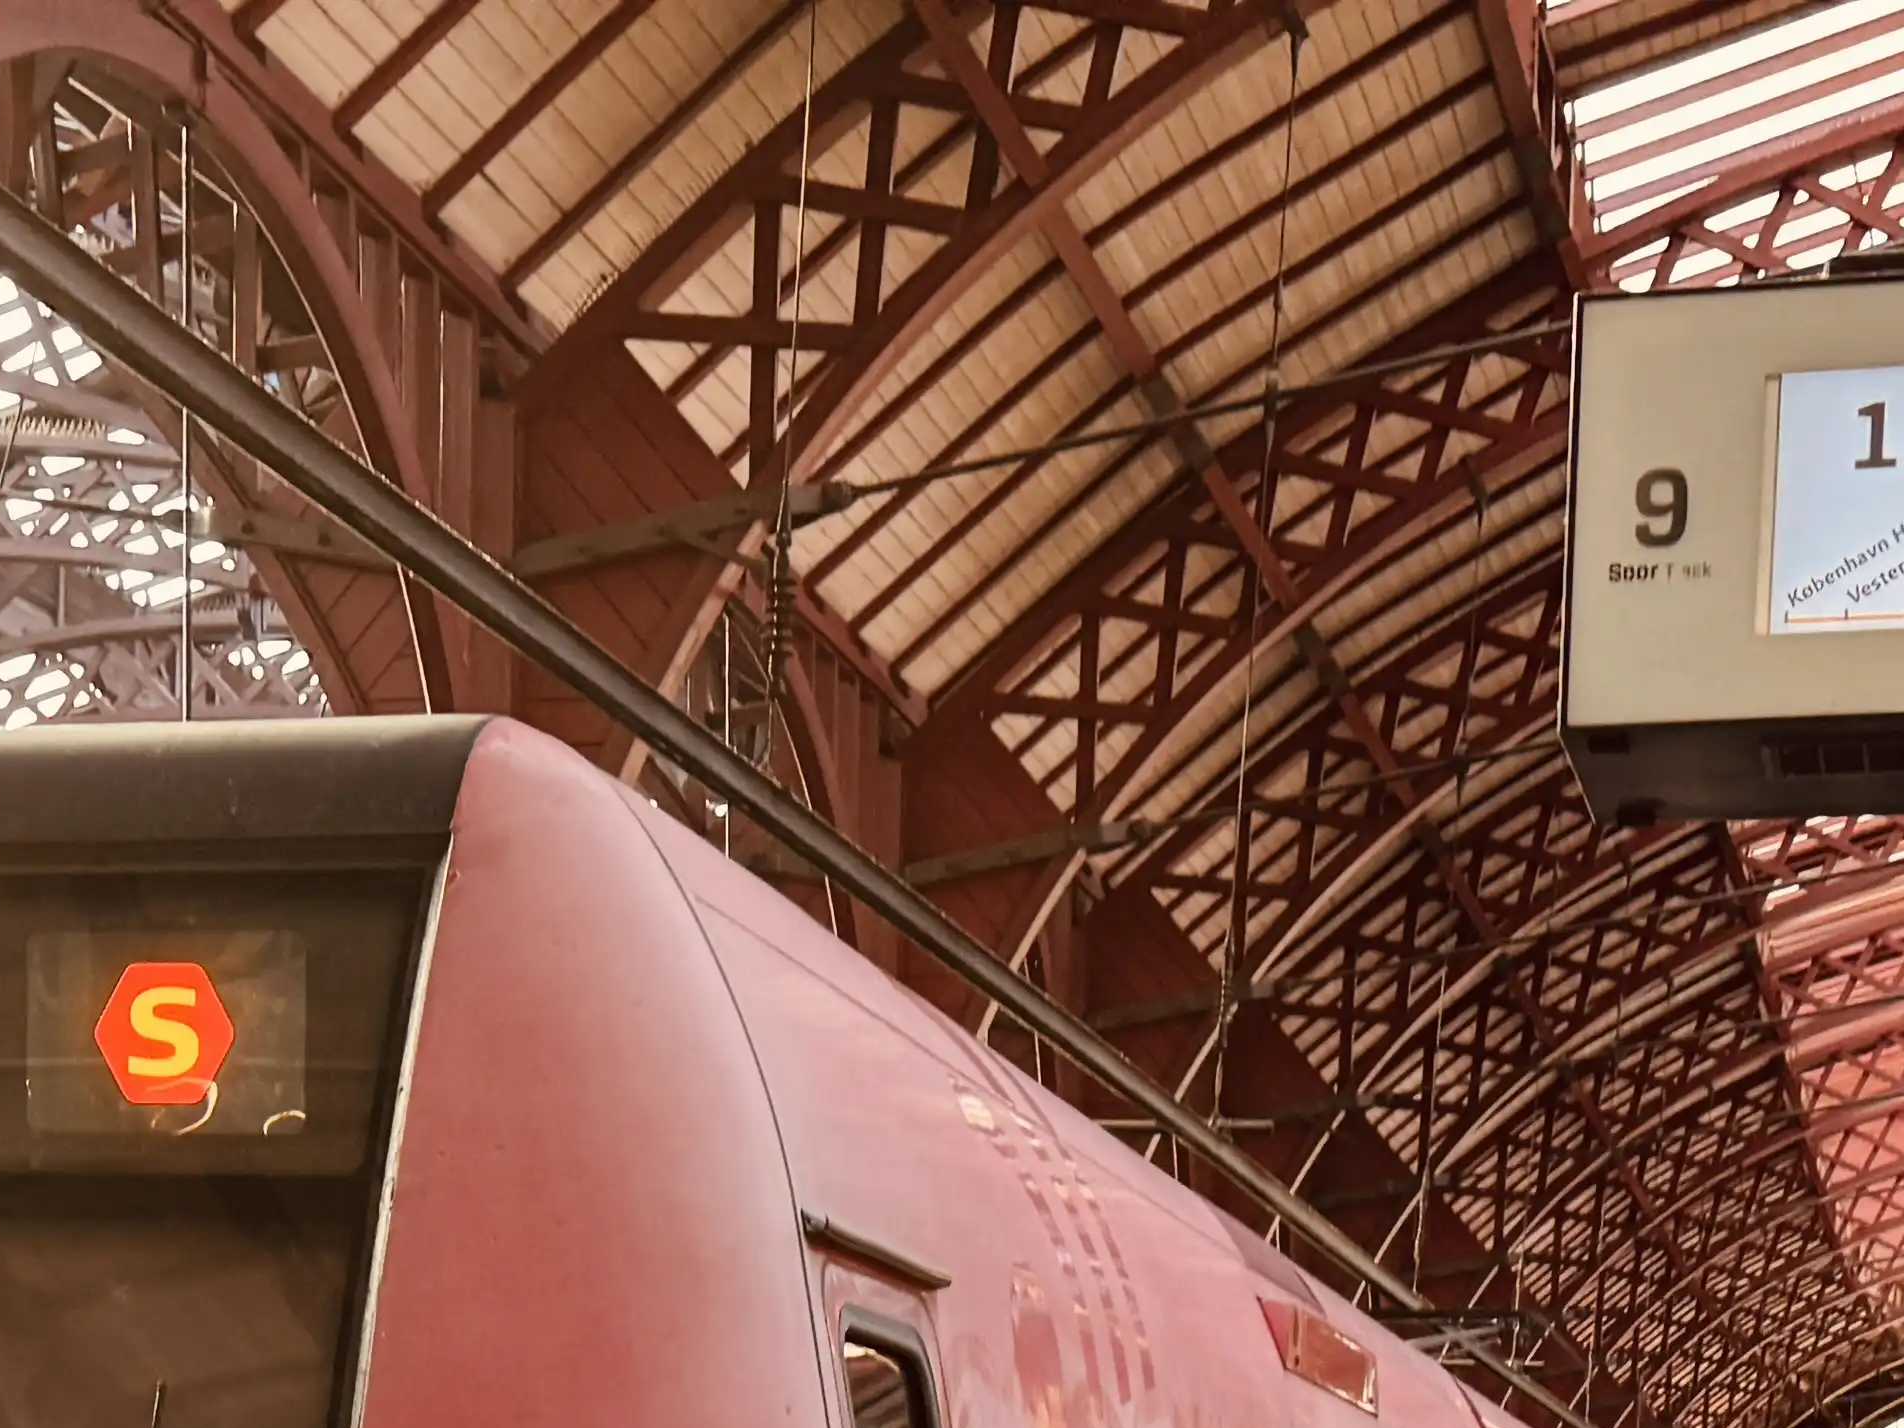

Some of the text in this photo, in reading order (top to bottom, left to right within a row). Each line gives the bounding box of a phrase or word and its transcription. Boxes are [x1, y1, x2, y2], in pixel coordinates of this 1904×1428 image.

[1854, 401, 1897, 470] 1
[1634, 467, 1689, 548] 9
[1787, 538, 1890, 608] København
[127, 985, 199, 1079] S
